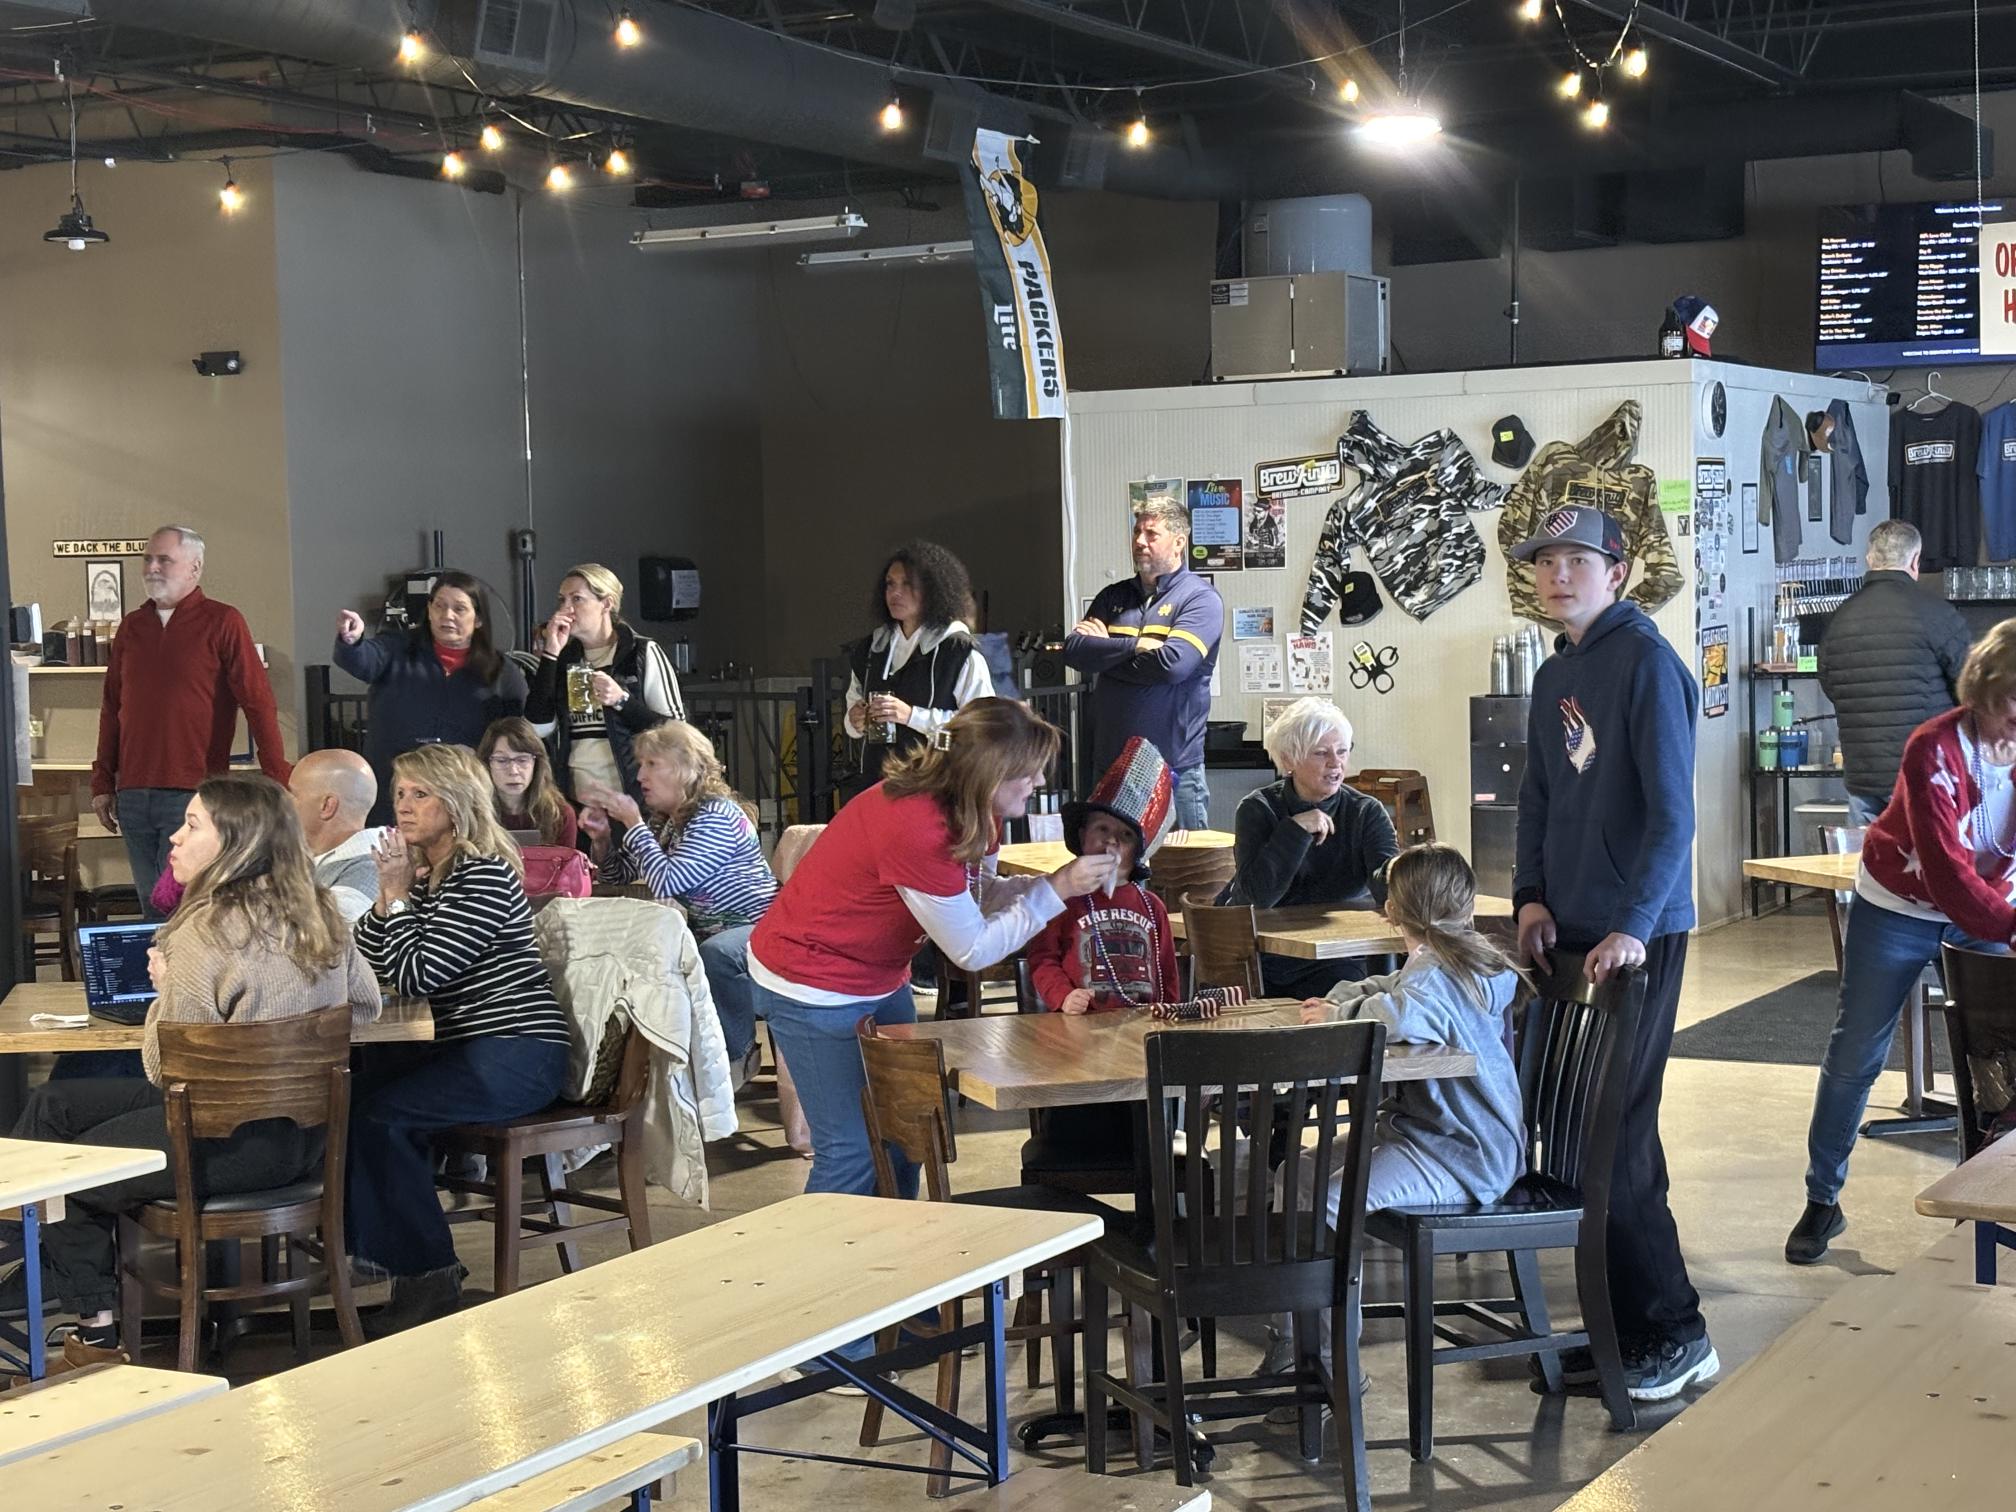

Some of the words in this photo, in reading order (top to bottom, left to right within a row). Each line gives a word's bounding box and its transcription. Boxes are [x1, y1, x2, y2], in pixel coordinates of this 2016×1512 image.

[993, 303, 1017, 351] Lite
[1018, 260, 1060, 398] PACKERS
[1204, 481, 1226, 494] Live
[1200, 492, 1230, 506] MUSIC
[56, 543, 70, 553] WE
[73, 543, 98, 553] BACK
[102, 542, 121, 552] THE
[125, 541, 147, 552] BLU
[1077, 909, 1109, 930] FIRE
[1109, 908, 1153, 933] RESCUE
